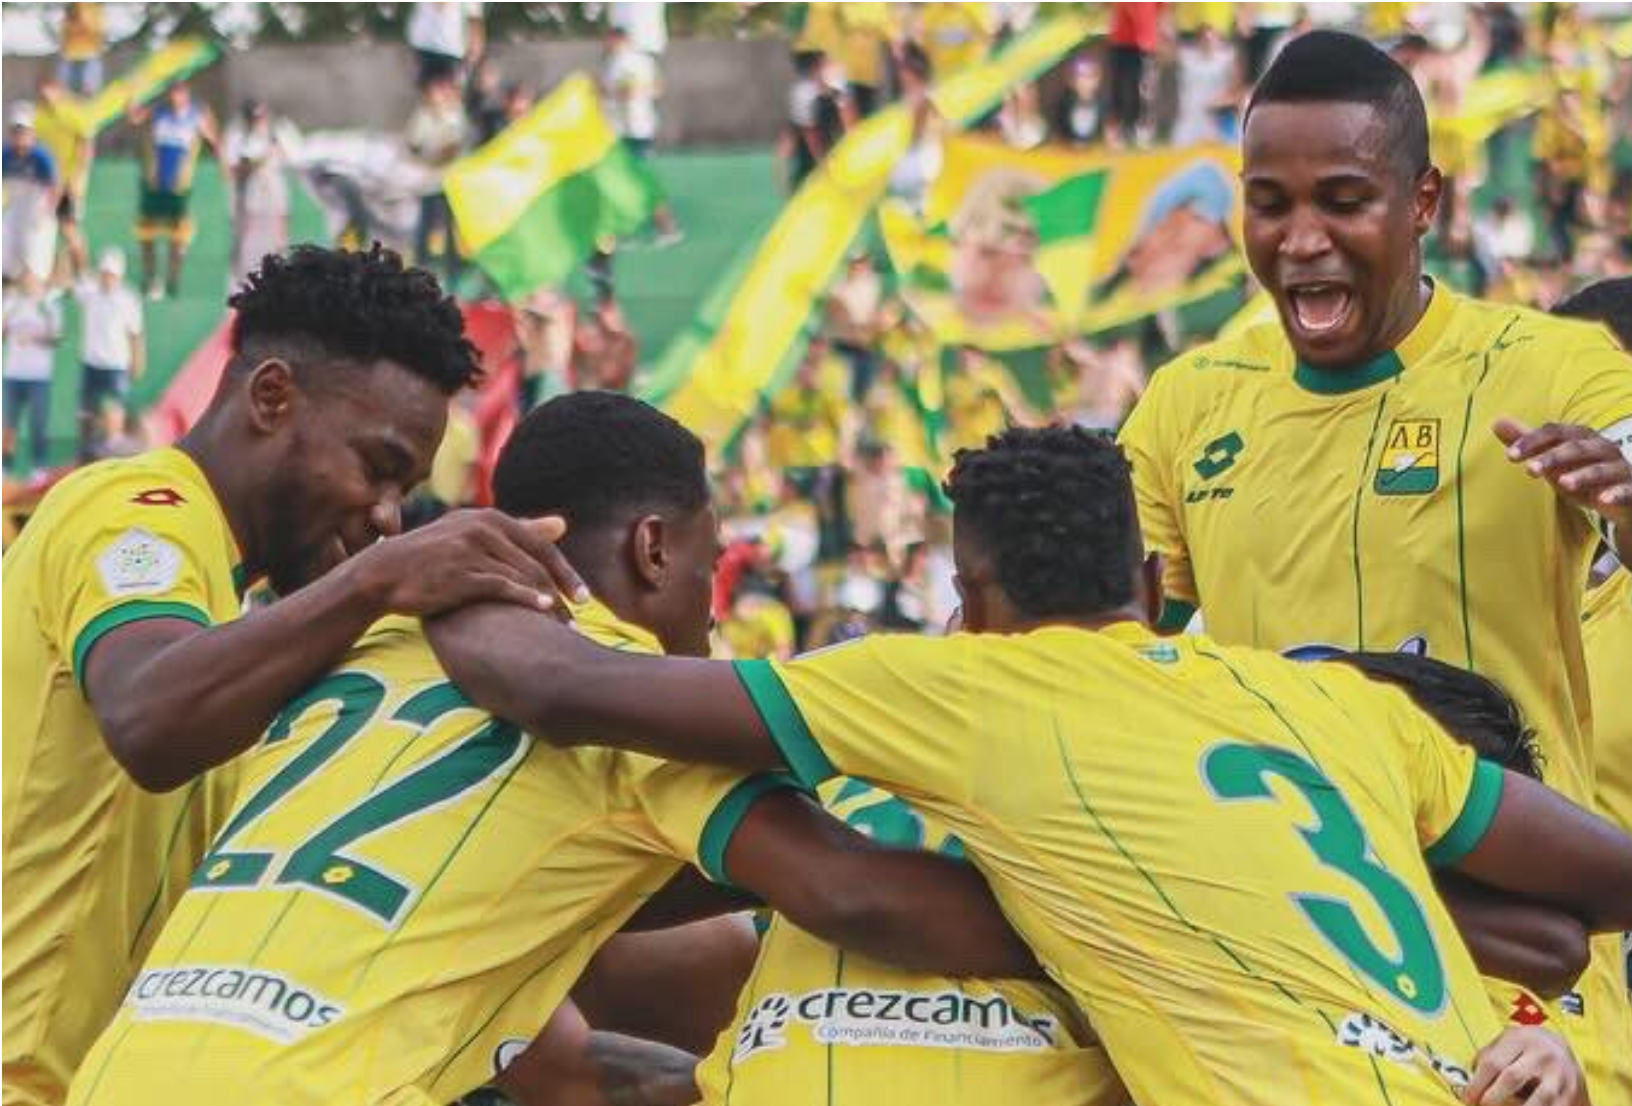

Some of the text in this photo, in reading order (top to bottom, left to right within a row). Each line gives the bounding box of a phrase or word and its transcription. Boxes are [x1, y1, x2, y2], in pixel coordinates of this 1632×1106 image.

[190, 670, 531, 926] 22
[1200, 741, 1449, 1020] 3
[137, 968, 341, 1028] crezcamos
